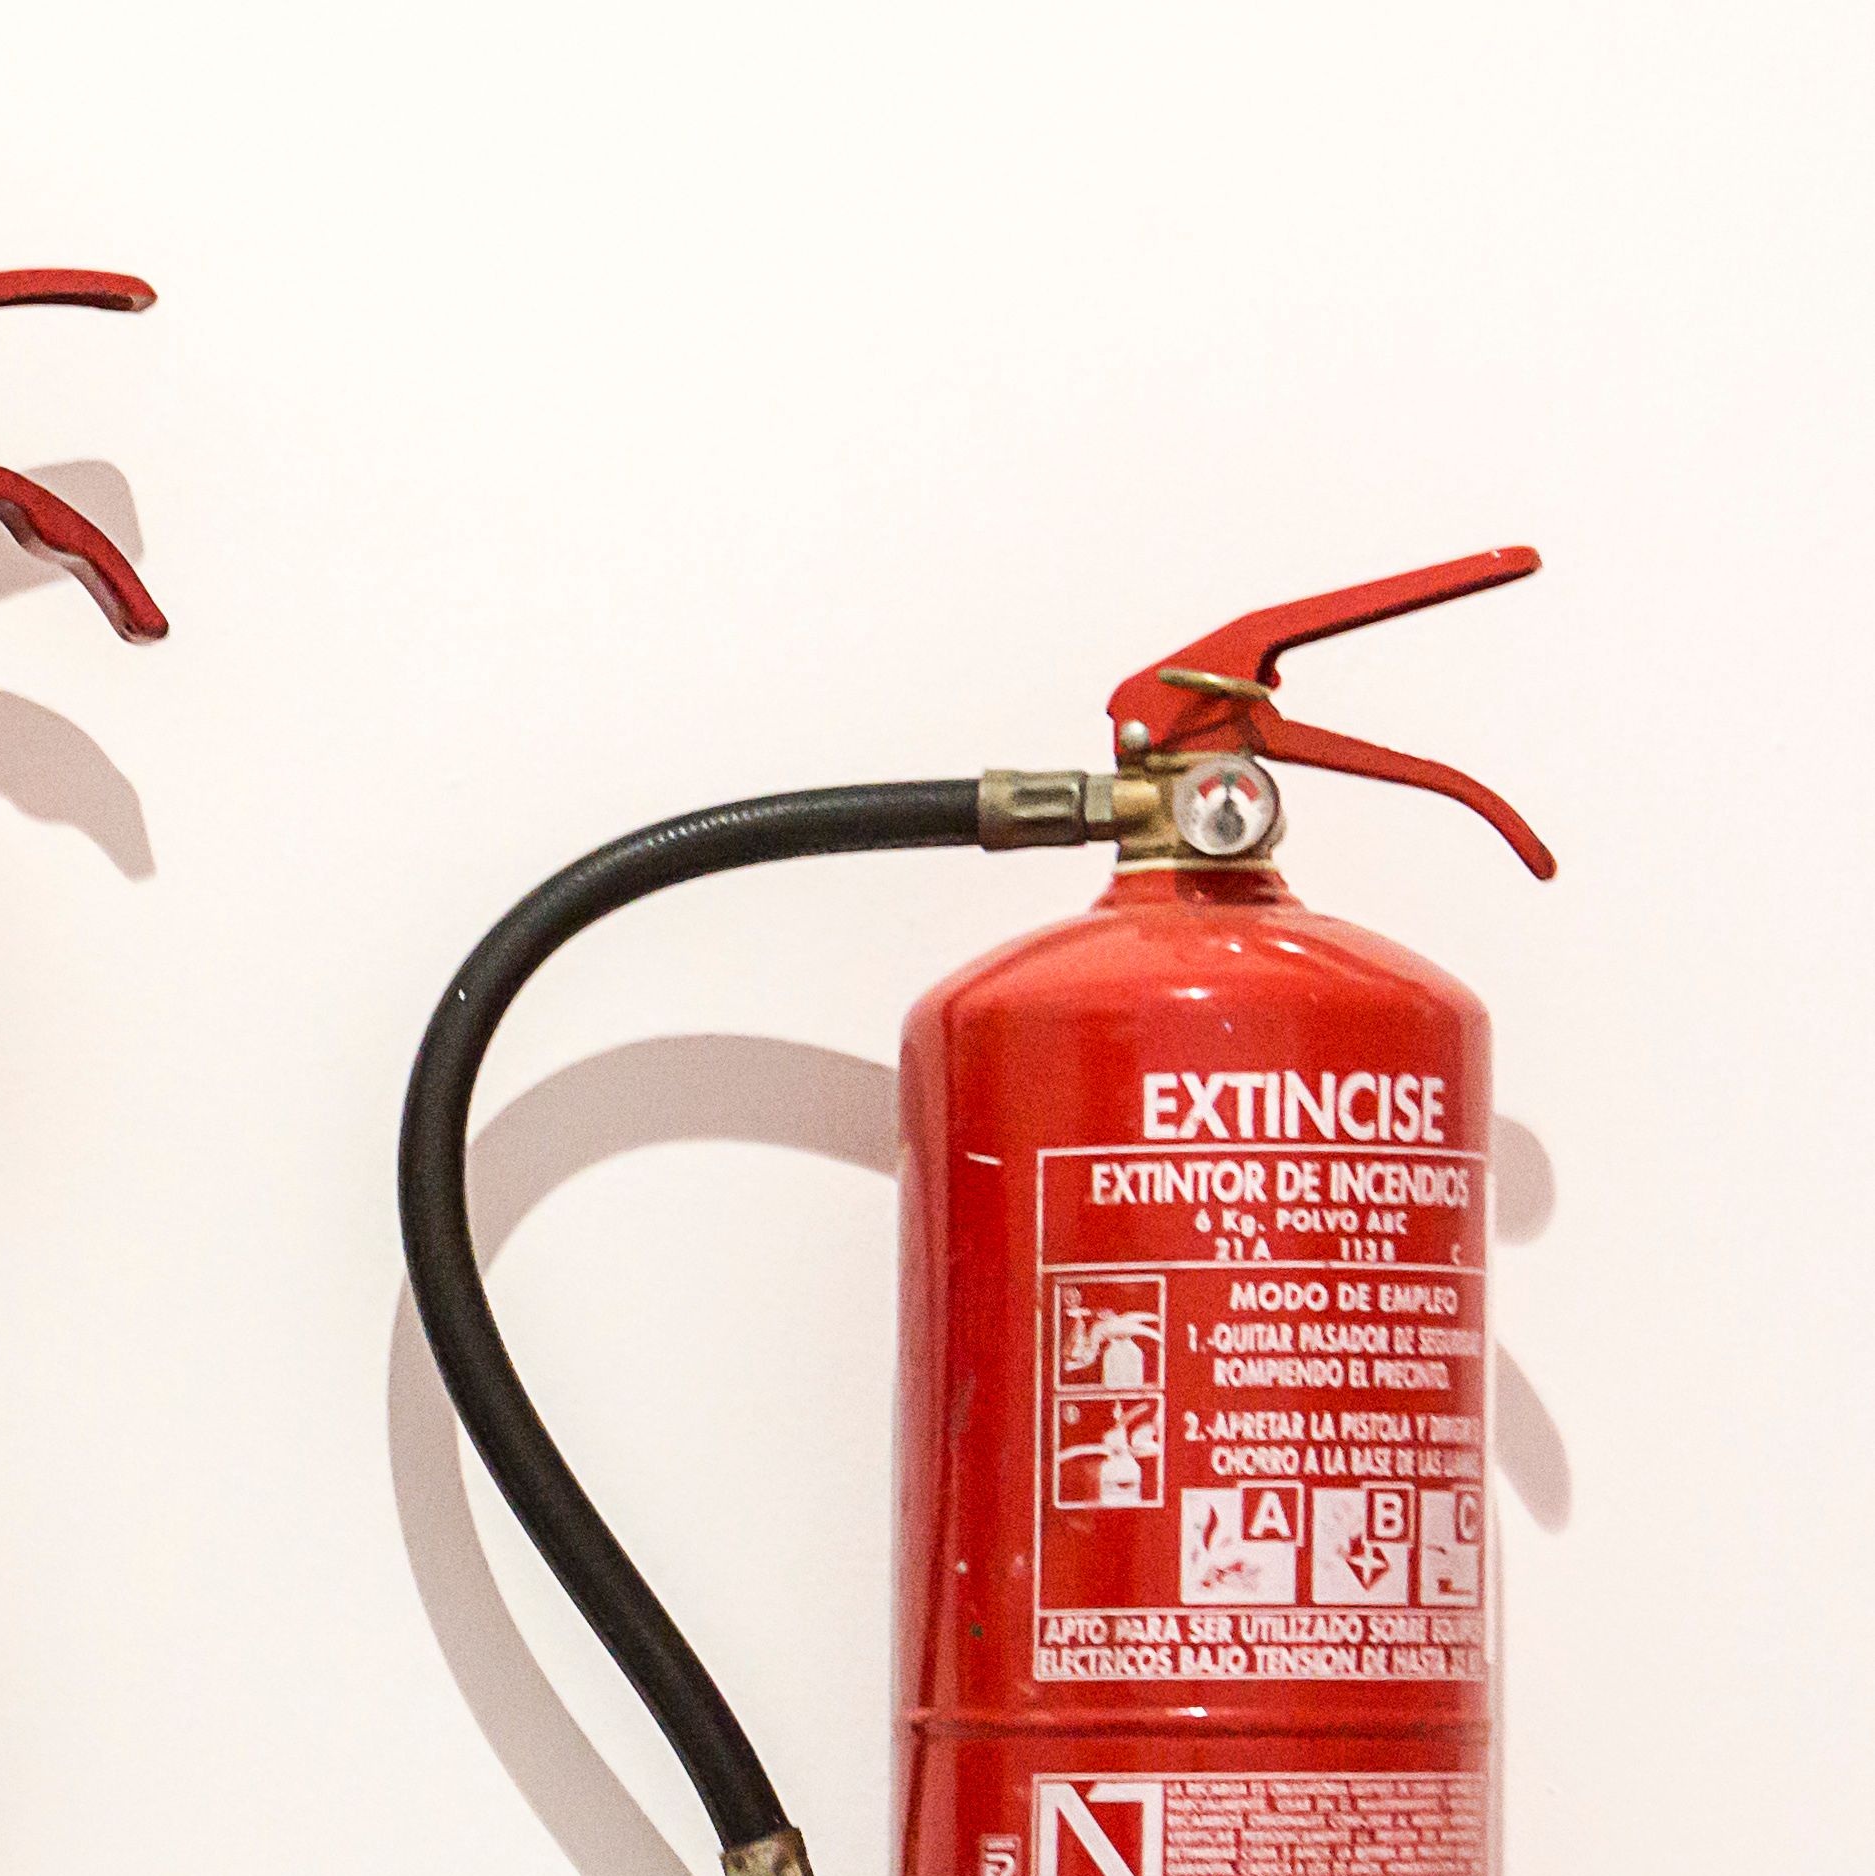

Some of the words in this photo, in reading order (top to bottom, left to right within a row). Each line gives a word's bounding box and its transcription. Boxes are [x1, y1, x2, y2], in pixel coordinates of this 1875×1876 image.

[1143, 1070, 1446, 1143] EXTINCISE
[1090, 1159, 1267, 1206] EXTINTOR
[1276, 1162, 1322, 1204] DE
[1330, 1163, 1470, 1210] INCENDIOS
[1194, 1209, 1212, 1233] 6
[1275, 1209, 1359, 1233] POLVO
[1366, 1211, 1408, 1235] ABC
[1214, 1238, 1244, 1261] 21
[1253, 1238, 1272, 1261] A
[1339, 1238, 1378, 1262] 113
[1229, 1281, 1329, 1312] MODO
[1338, 1283, 1374, 1312] DE
[1379, 1285, 1459, 1314] EMPLEO
[1299, 1325, 1390, 1354] PASADOR
[1212, 1359, 1344, 1389] ROMPIENDO
[1310, 1413, 1336, 1442] LA
[1211, 1446, 1300, 1476] CHORRO
[1323, 1448, 1346, 1476] LA
[1248, 1490, 1291, 1538] A
[1374, 1492, 1406, 1538] B
[1043, 1616, 1110, 1644] APTO
[1190, 1616, 1234, 1643] SER
[1240, 1616, 1362, 1644] UTILIZADO
[1180, 1647, 1249, 1677] BAJO
[1254, 1648, 1359, 1678] TENSION
